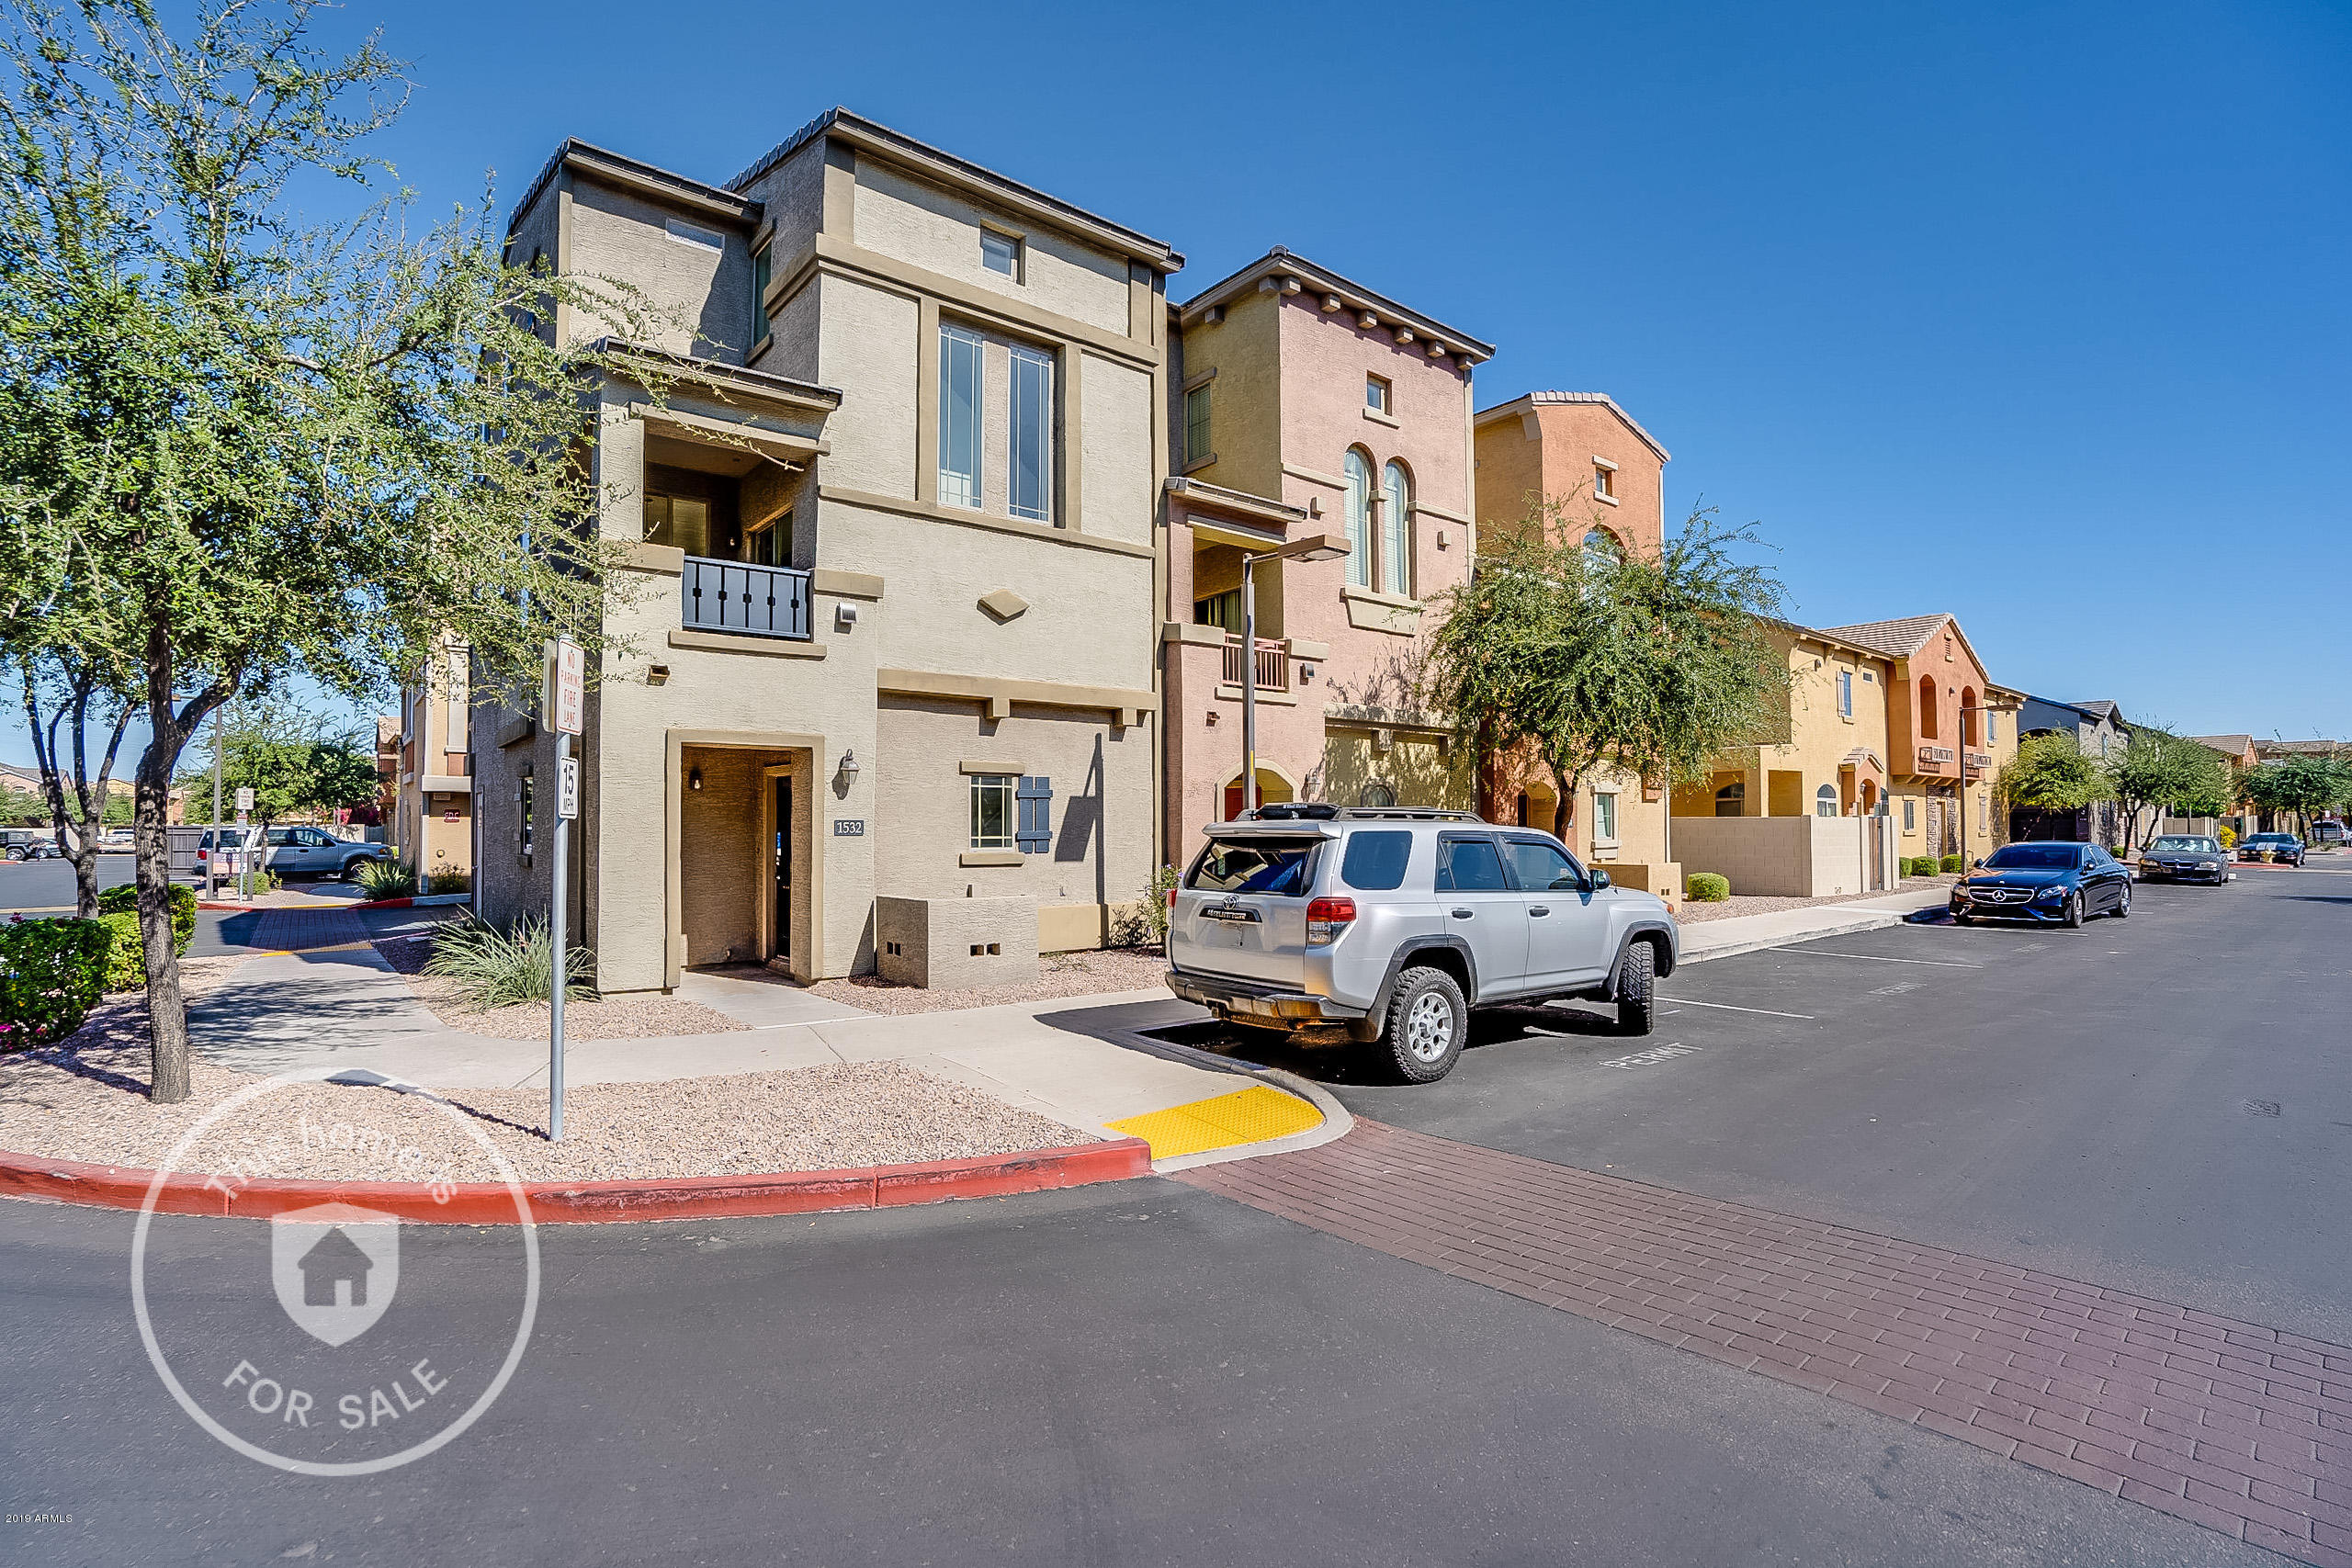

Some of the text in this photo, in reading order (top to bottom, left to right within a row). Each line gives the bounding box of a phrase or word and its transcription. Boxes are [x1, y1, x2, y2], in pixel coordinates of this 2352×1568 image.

[566, 651, 576, 669] NO
[560, 669, 581, 689] PARKING
[563, 688, 577, 708] FIRE
[563, 709, 576, 726] LANE
[563, 763, 574, 795] 15
[563, 797, 574, 812] MPH
[837, 821, 863, 834] 1532
